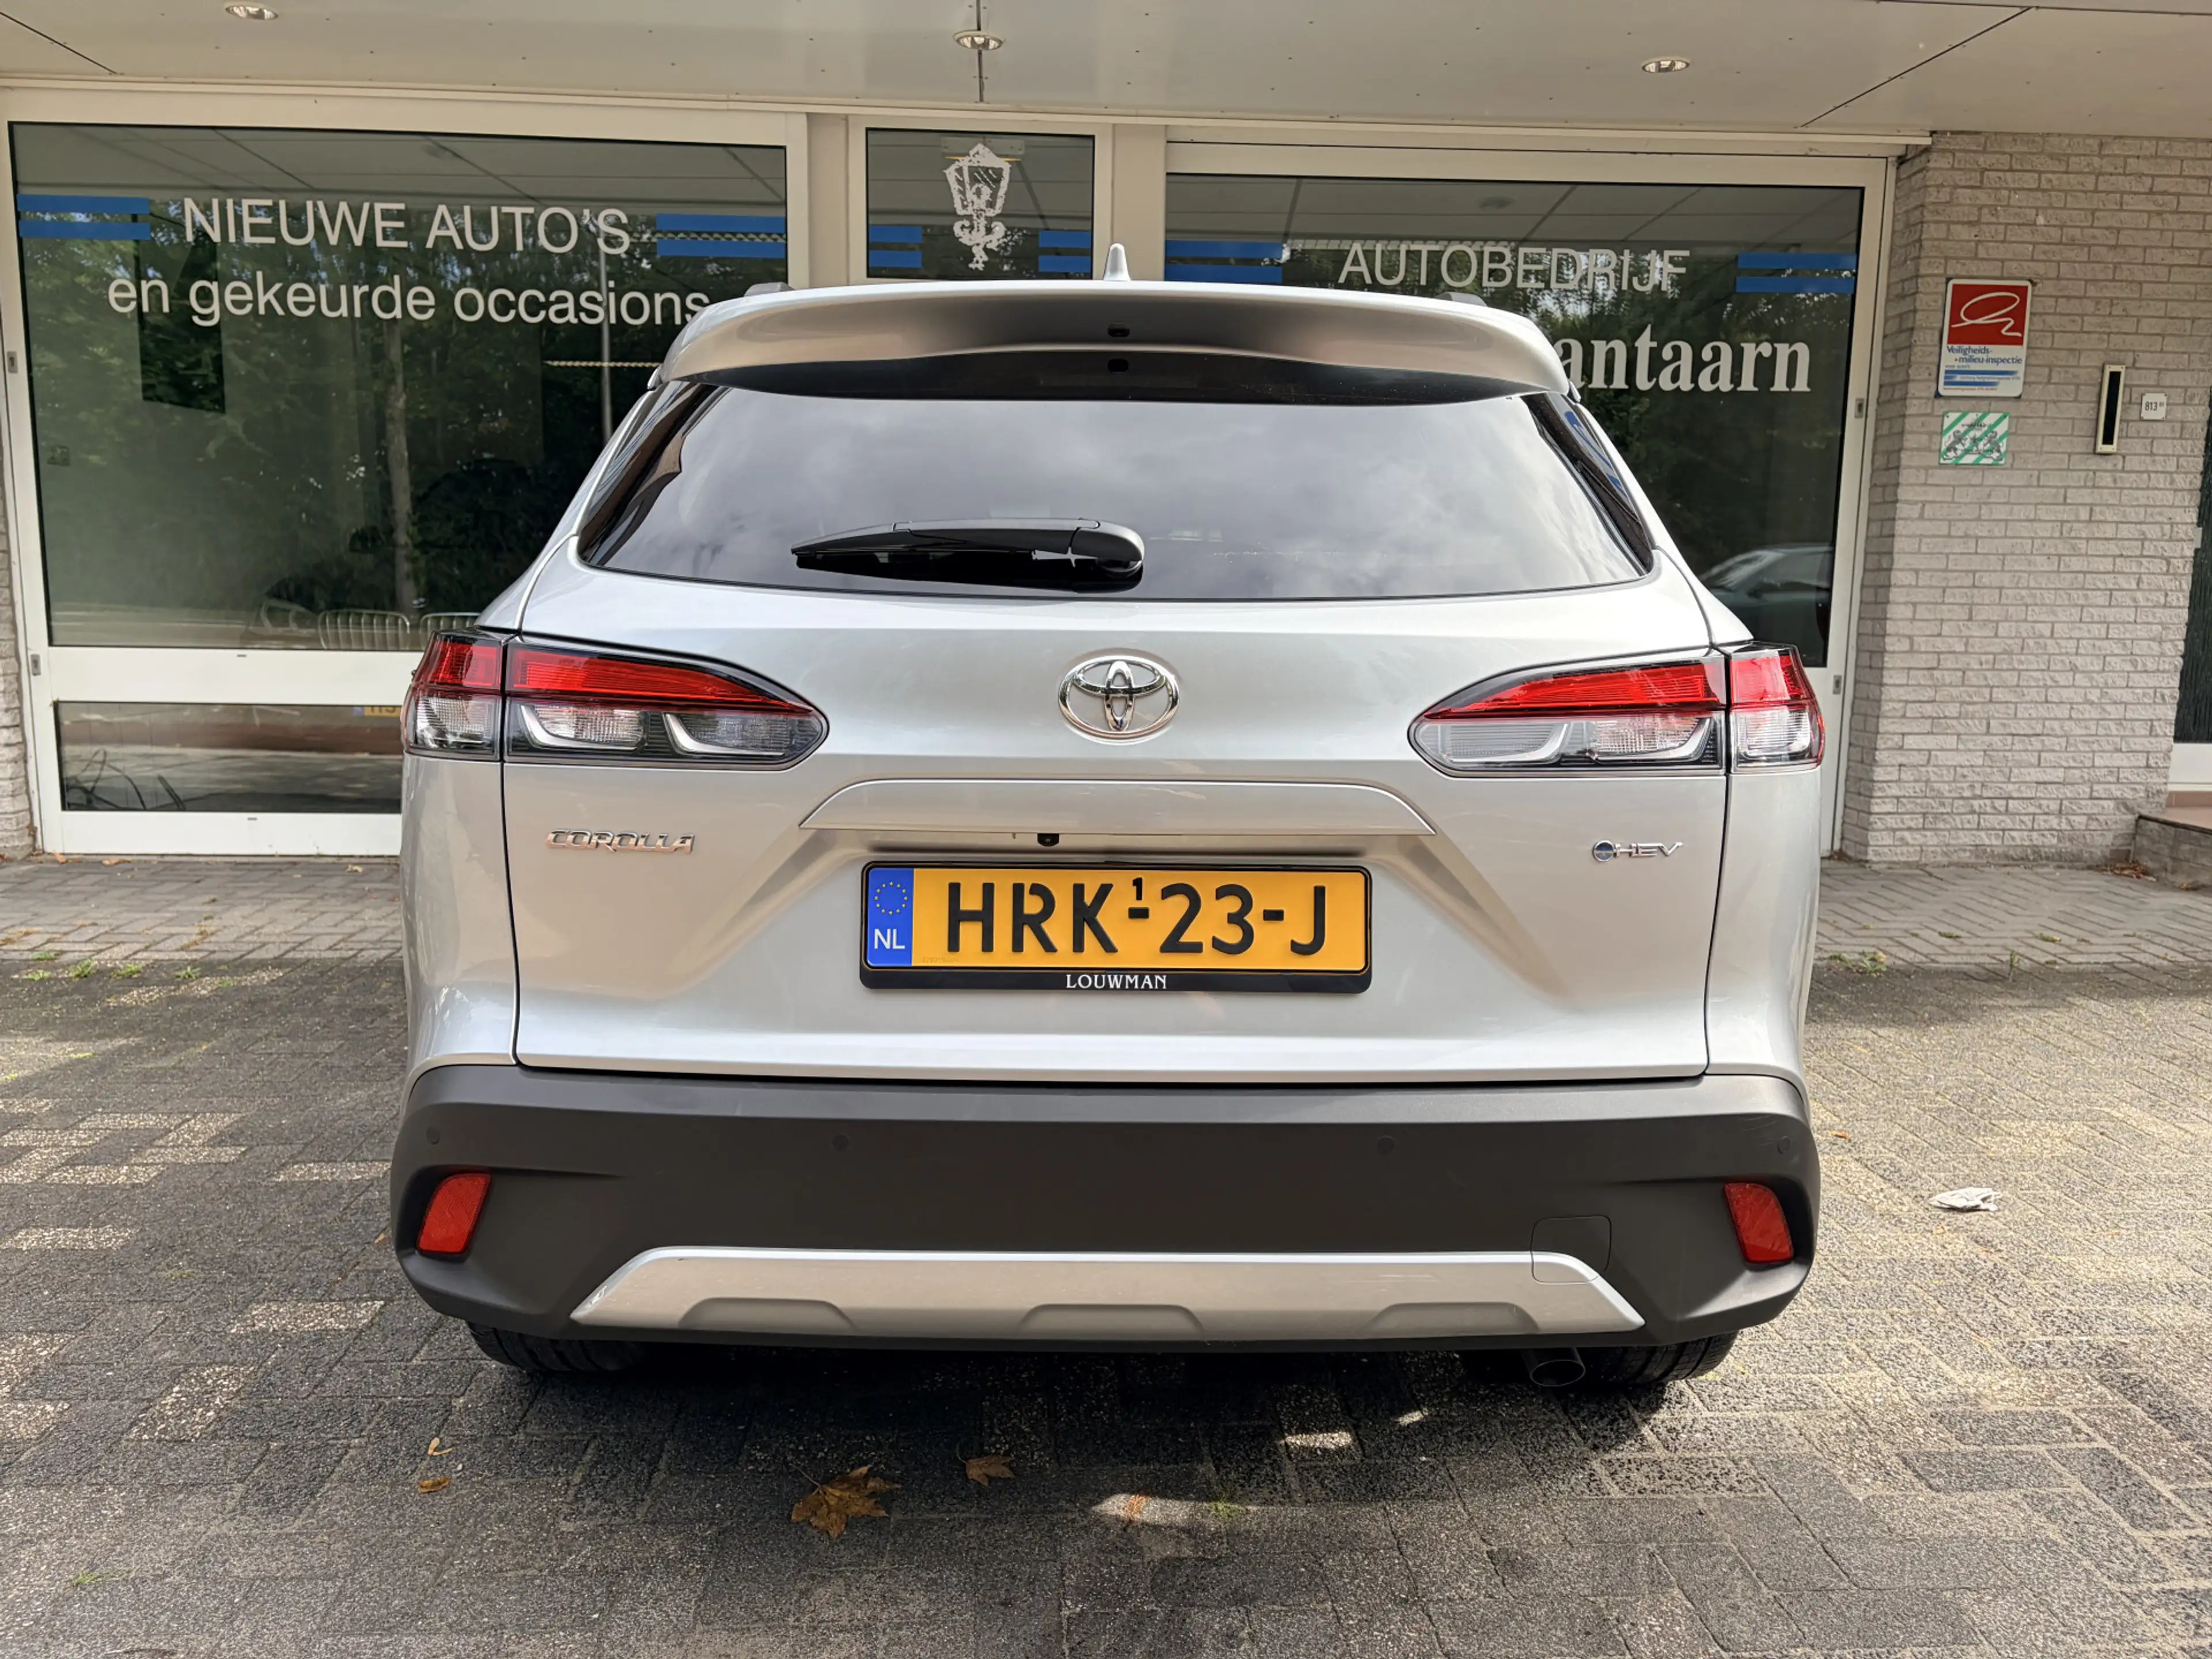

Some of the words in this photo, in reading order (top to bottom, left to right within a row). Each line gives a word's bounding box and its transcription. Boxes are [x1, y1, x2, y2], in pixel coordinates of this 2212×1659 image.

[184, 198, 408, 248] NIEUWE
[425, 204, 630, 255] AUTO'S
[1338, 243, 1691, 292] AUTOBEDRIJF
[109, 275, 170, 315] en
[189, 271, 435, 327] gekeurde
[454, 280, 710, 327] occasions
[1554, 323, 1812, 393] antaarn
[546, 828, 695, 854] COROLLA
[874, 928, 906, 949] NL
[1066, 974, 1167, 990] LOUWMAN
